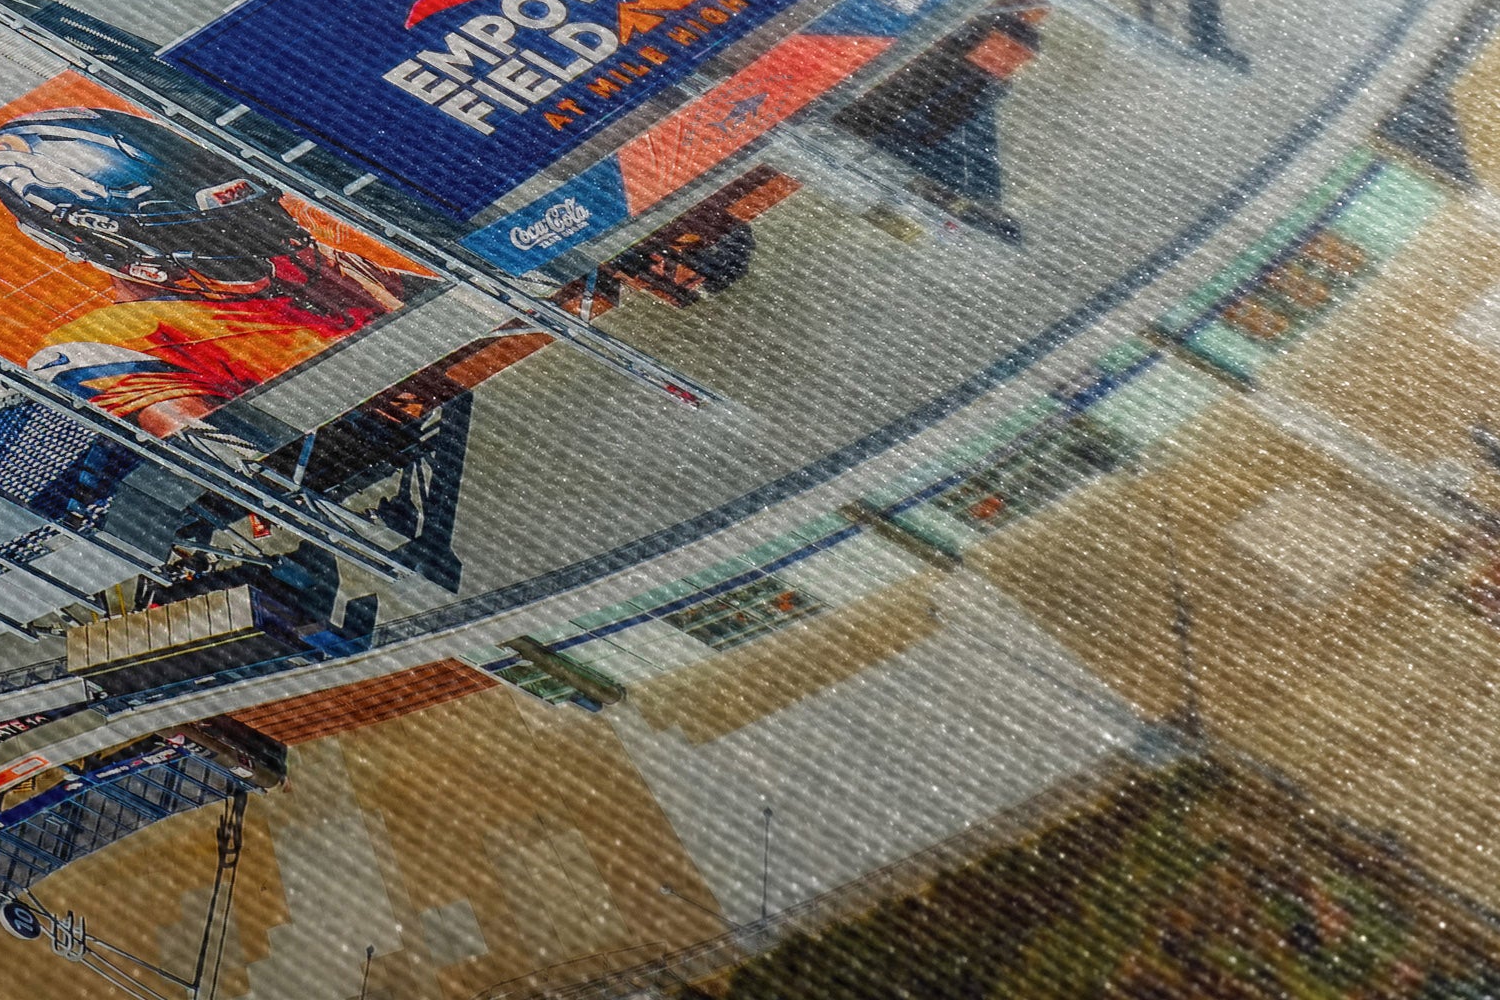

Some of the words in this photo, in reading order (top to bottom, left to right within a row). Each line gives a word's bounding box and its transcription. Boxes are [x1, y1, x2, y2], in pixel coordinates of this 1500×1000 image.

[438, 22, 619, 136] FIELD
[542, 98, 588, 132] AT
[586, 45, 670, 99] MILE
[13, 907, 35, 933] 10
